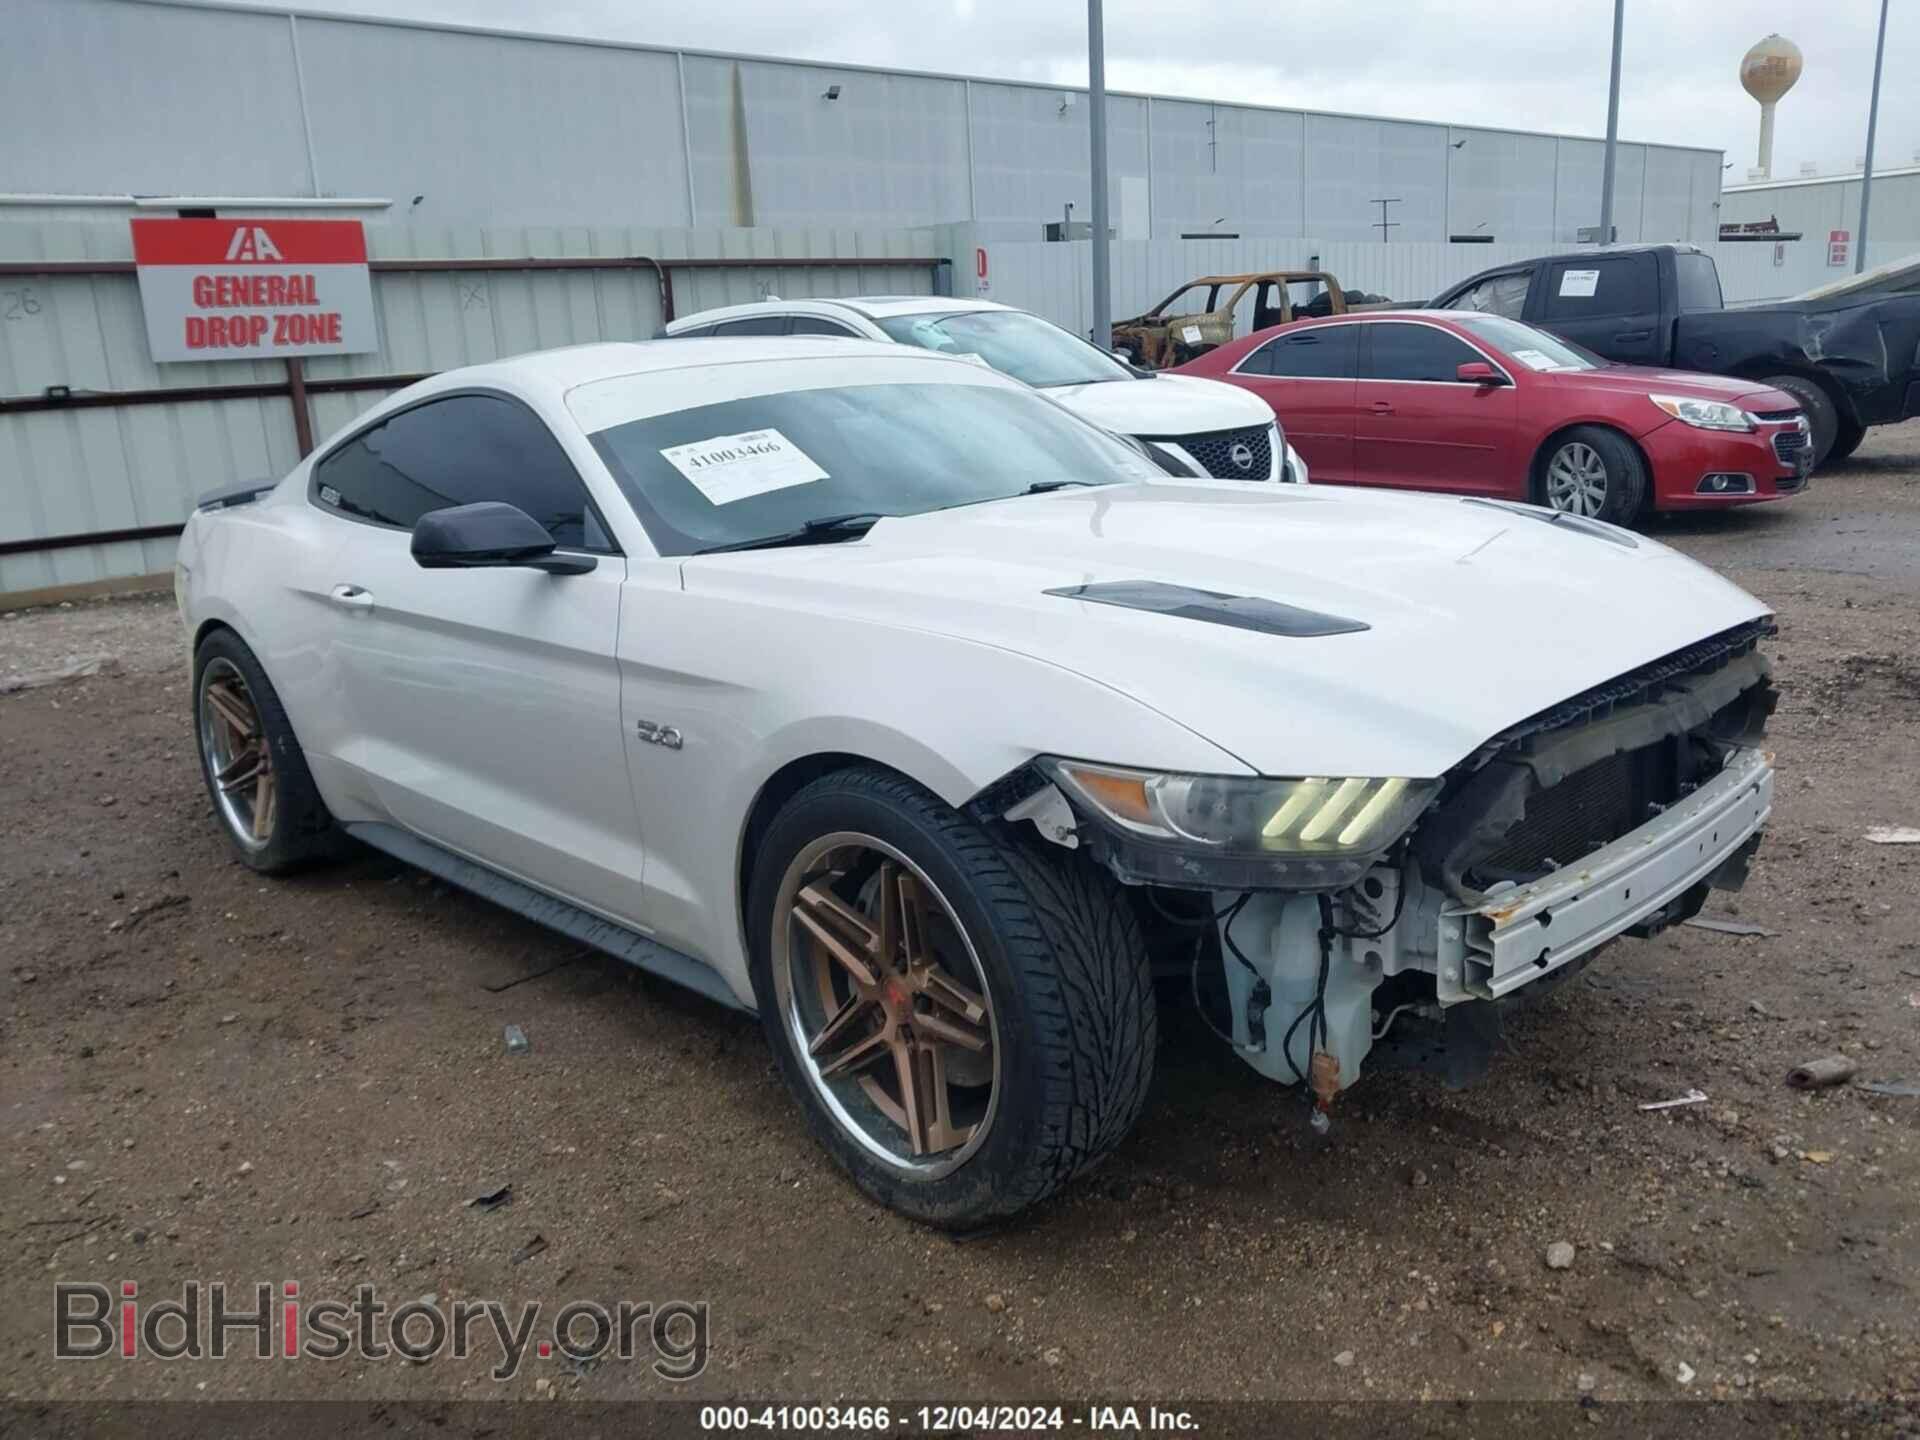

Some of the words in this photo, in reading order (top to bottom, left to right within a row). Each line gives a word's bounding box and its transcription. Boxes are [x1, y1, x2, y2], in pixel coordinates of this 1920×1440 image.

[192, 274, 320, 308] GENERAL
[185, 315, 268, 349] DROP
[272, 313, 343, 345] ZONE
[690, 441, 782, 468] 41003466
